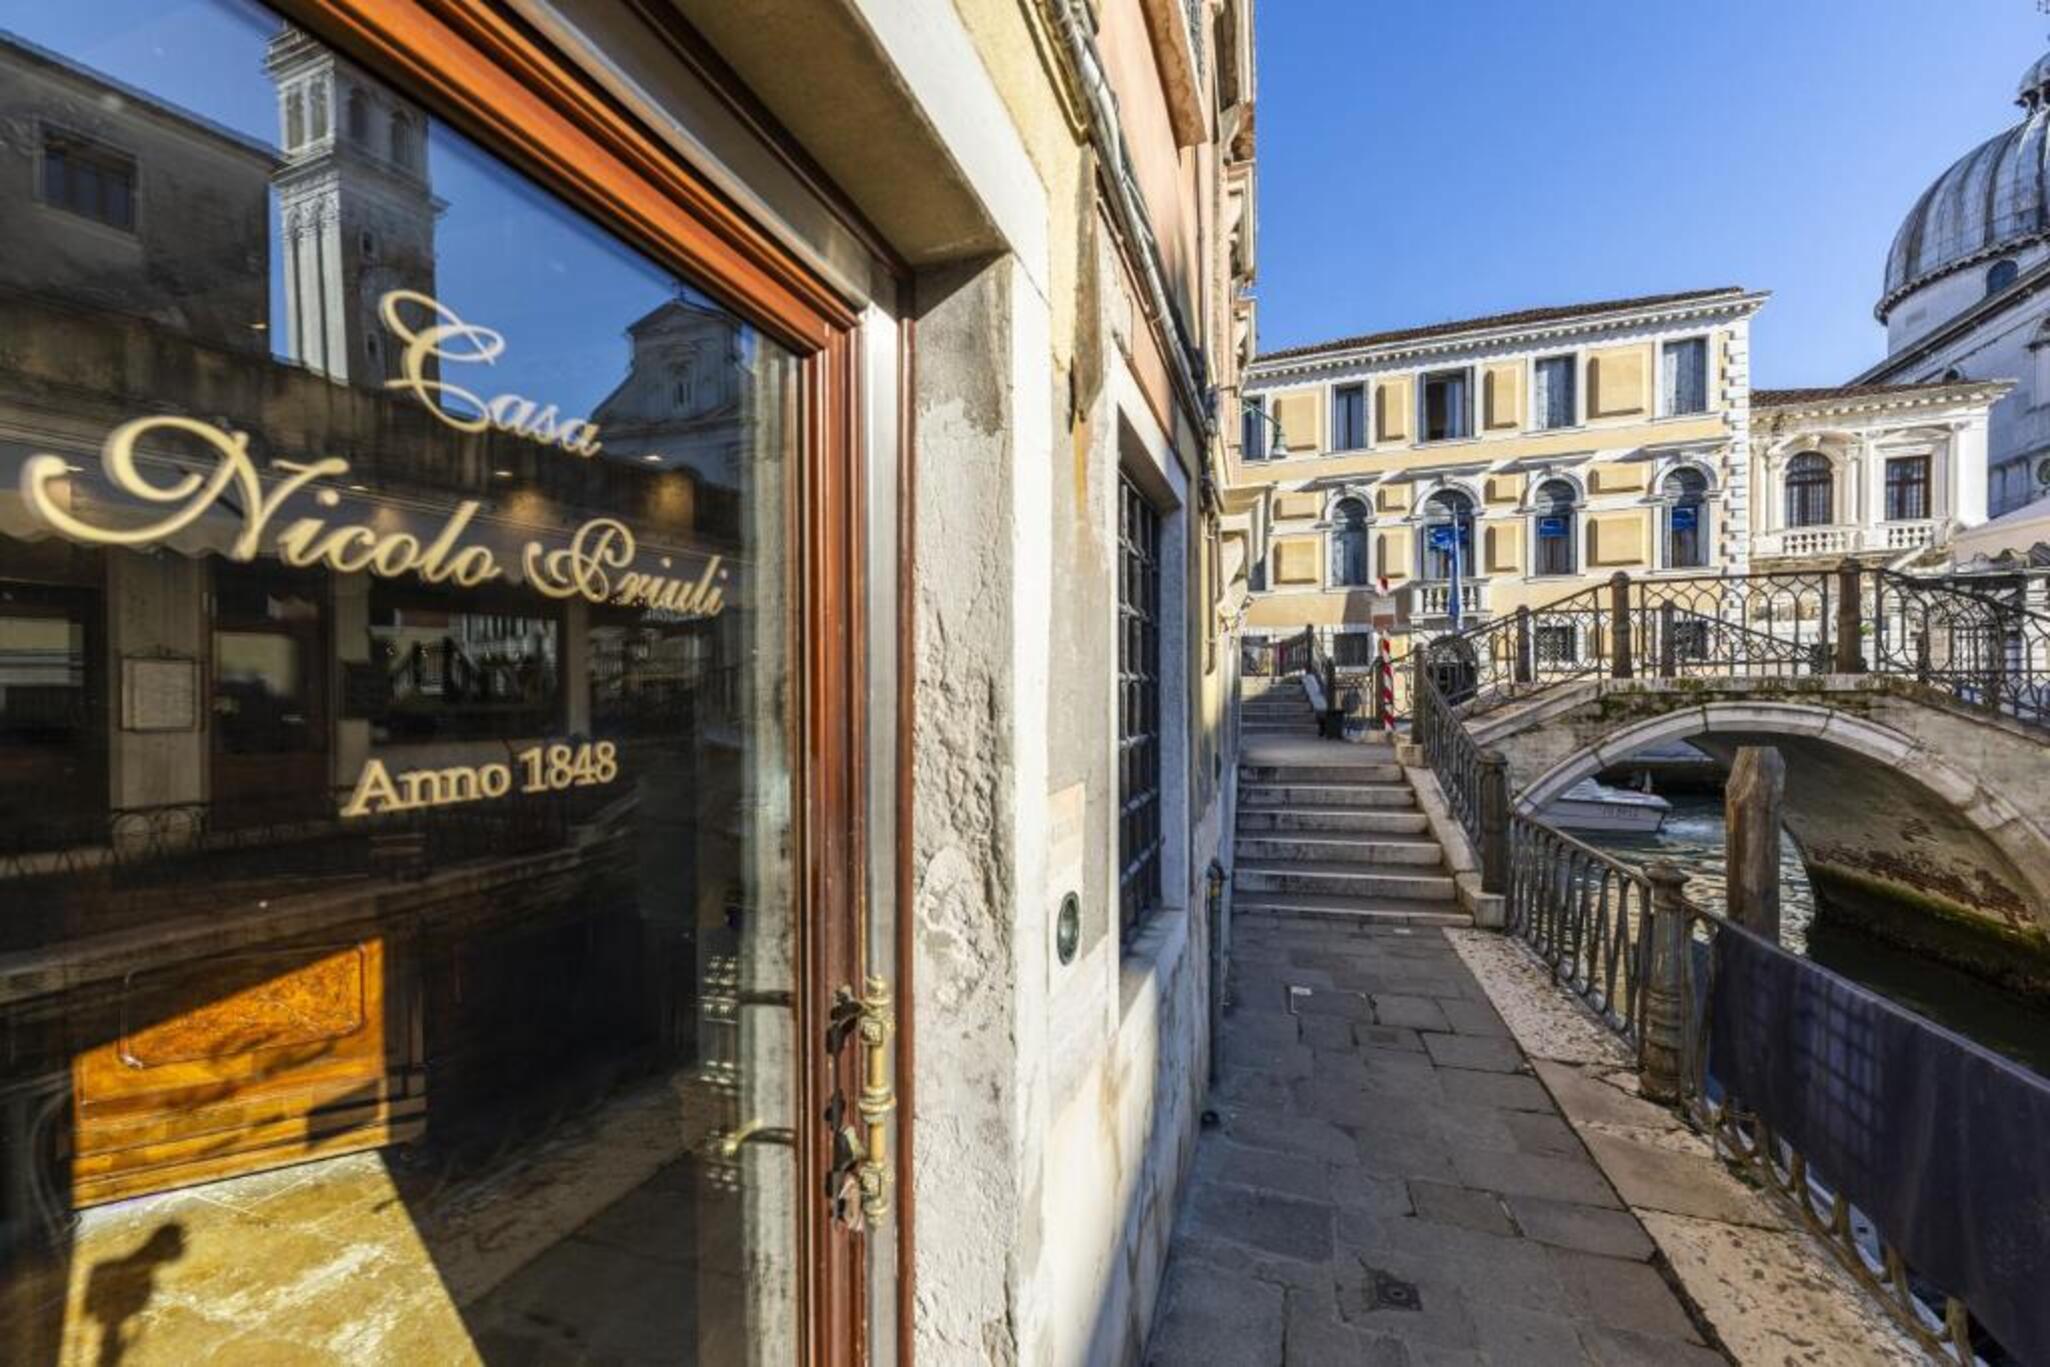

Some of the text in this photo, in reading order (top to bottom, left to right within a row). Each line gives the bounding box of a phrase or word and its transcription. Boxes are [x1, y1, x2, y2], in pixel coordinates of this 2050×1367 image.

[379, 289, 602, 457] Casa
[20, 415, 727, 617] Nicolo Priuli
[340, 741, 617, 817] Anno 1848
